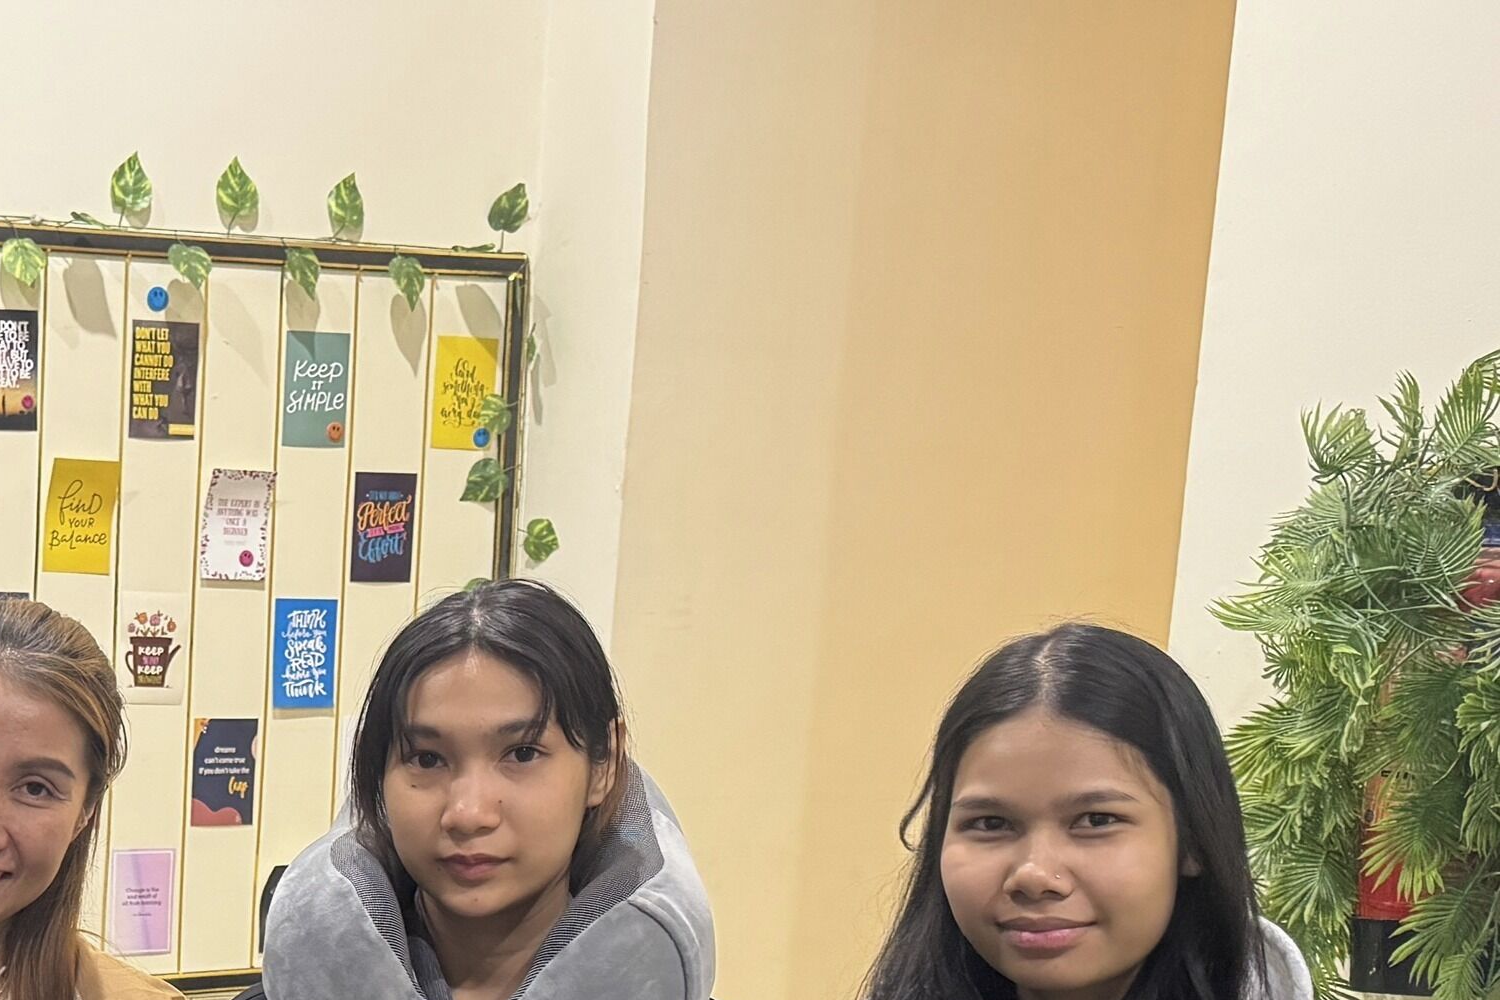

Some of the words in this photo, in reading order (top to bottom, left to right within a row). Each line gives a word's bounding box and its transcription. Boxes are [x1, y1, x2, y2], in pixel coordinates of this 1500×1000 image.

[4, 330, 17, 342] TO
[156, 327, 169, 341] LET
[11, 341, 26, 351] TO
[135, 340, 156, 353] WHAT
[157, 341, 171, 354] YOU
[11, 350, 28, 361] BUT
[135, 353, 162, 367] CANNOT
[163, 355, 173, 367] DO
[20, 359, 34, 371] TO
[19, 369, 31, 379] BE
[134, 367, 170, 381] INTERFERE
[133, 380, 151, 393] WITH
[311, 380, 324, 390] IT
[133, 393, 153, 406] WHAT
[154, 394, 168, 407] YOU
[133, 406, 148, 419] CAN
[148, 408, 159, 420] DO
[357, 495, 412, 531] Perfect
[68, 518, 95, 528] YOUR
[358, 532, 406, 563] Effort
